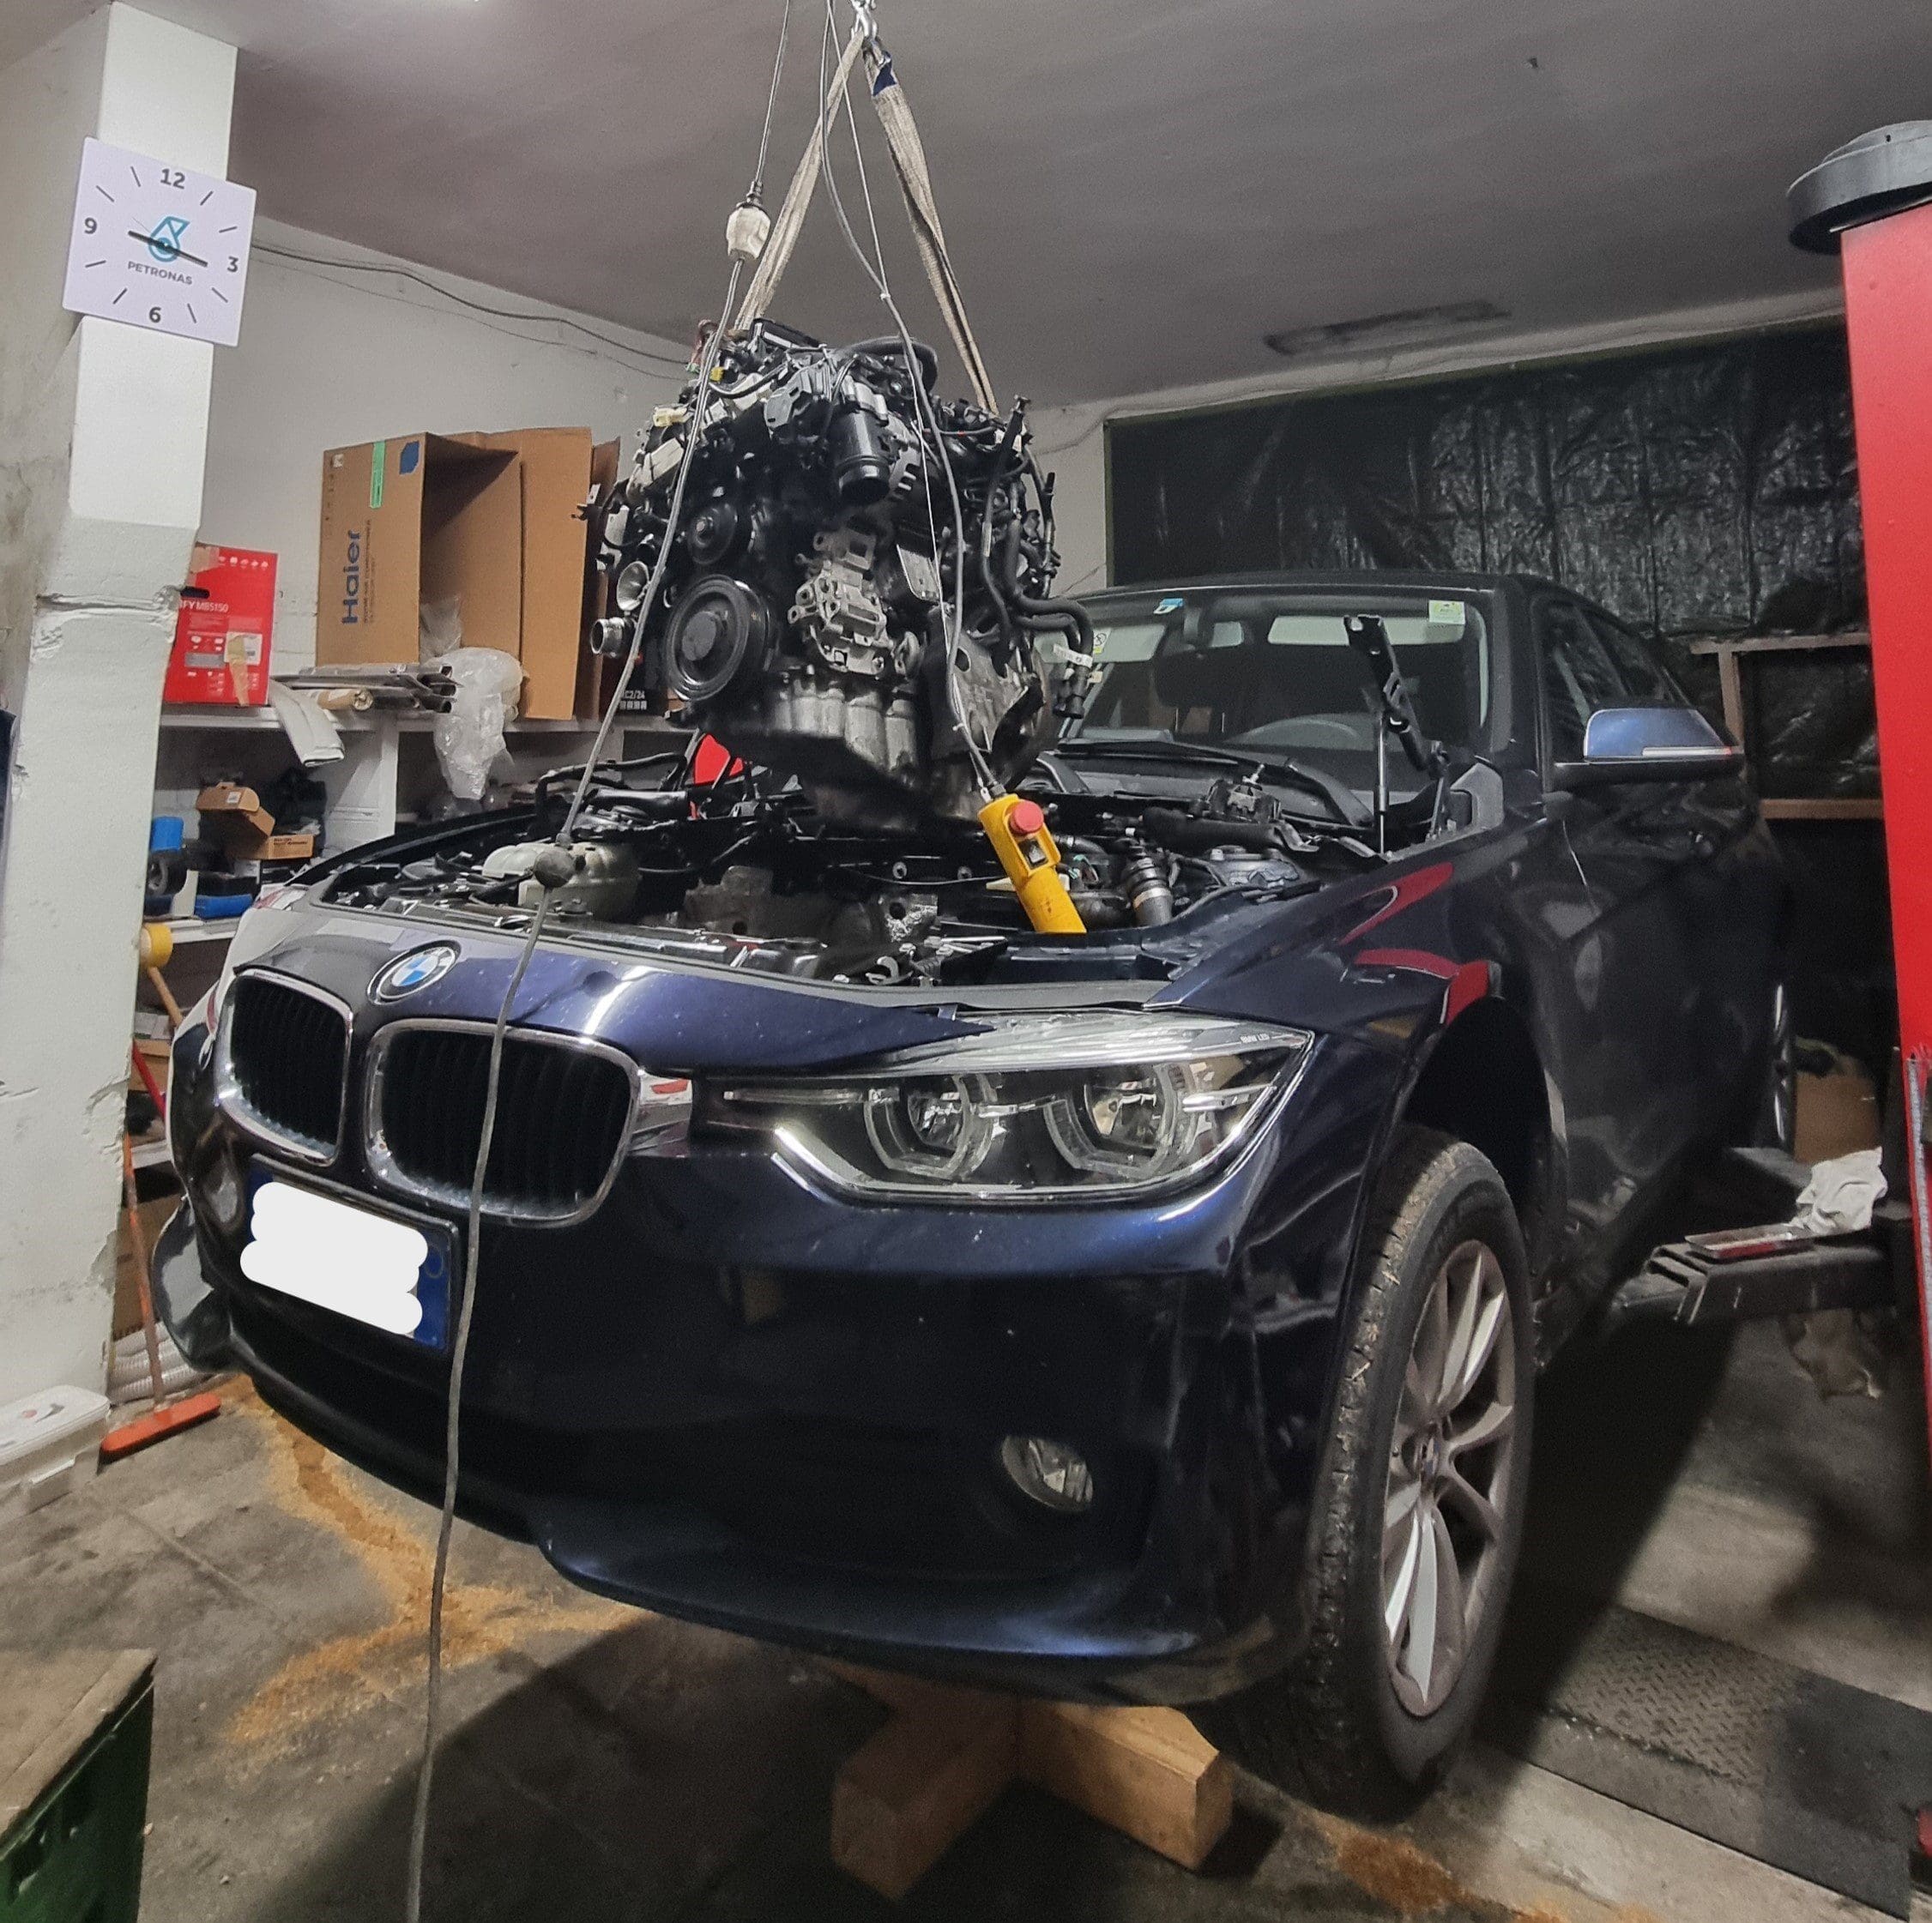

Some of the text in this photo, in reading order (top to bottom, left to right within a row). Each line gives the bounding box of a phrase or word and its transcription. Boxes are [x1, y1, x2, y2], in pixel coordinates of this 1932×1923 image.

[160, 168, 186, 190] 12
[83, 217, 98, 235] 9
[128, 261, 193, 286] PETRONAS
[226, 256, 239, 273] 3
[148, 306, 162, 323] 6
[341, 529, 360, 624] Haier
